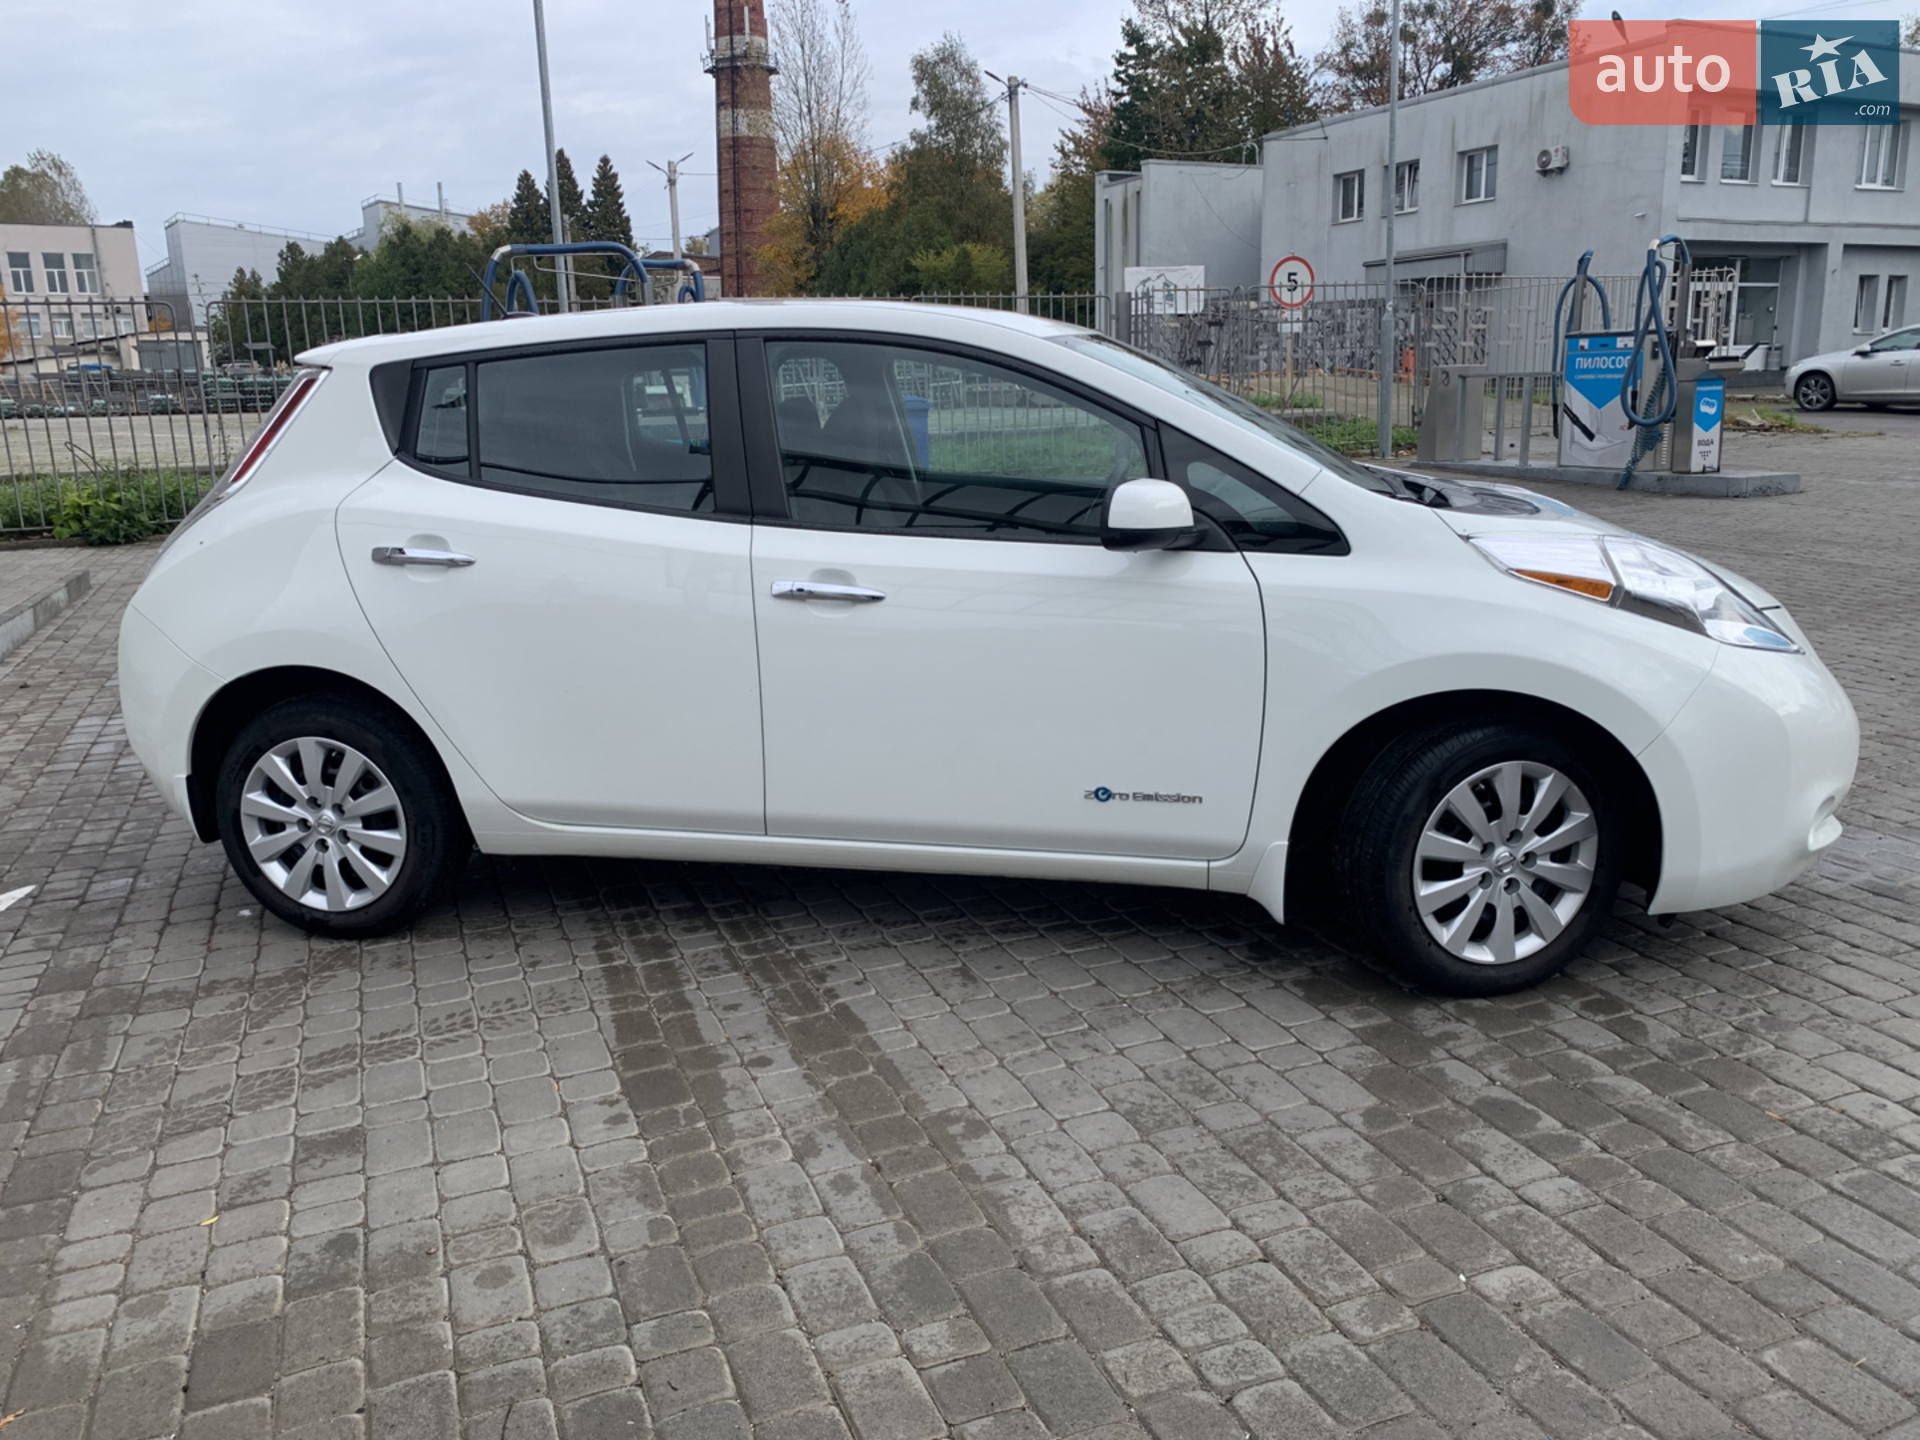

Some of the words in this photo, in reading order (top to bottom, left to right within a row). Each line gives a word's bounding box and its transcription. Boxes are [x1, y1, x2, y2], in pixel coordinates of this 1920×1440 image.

[1286, 272, 1298, 293] 5
[1084, 786, 1130, 802] Zero
[1132, 791, 1203, 804] Emission
